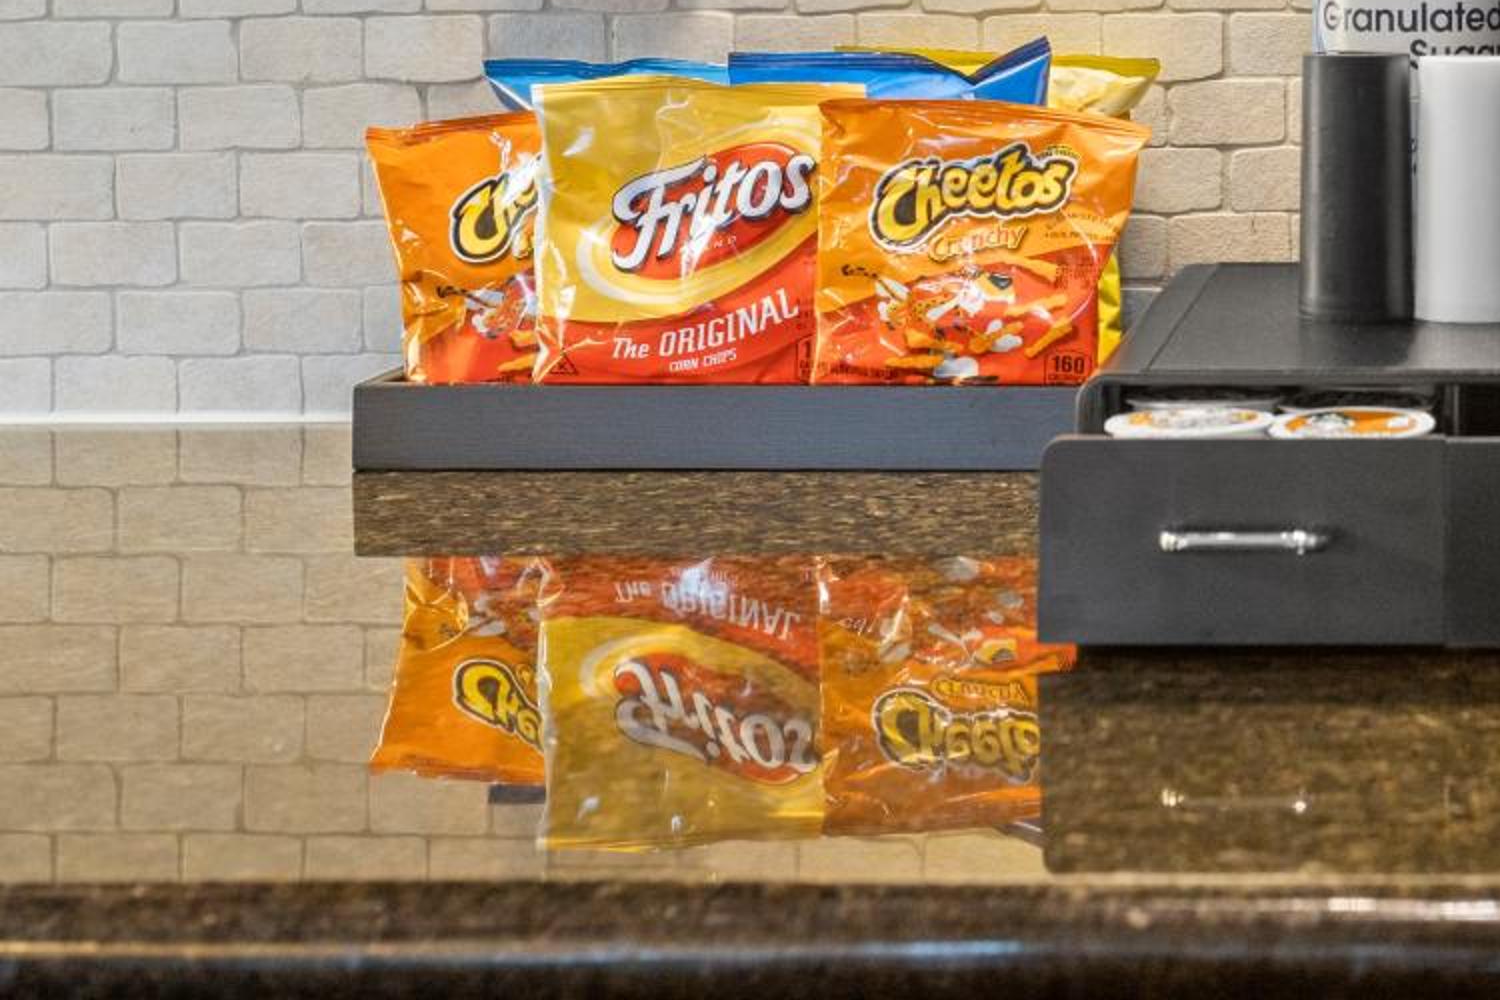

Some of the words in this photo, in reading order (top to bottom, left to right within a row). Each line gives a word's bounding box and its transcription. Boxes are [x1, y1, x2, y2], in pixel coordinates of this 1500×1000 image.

[612, 154, 815, 272] Fritos
[870, 142, 1078, 253] Cheetos
[612, 337, 650, 360] The
[659, 287, 799, 357] ORIGINAL
[669, 356, 699, 372] CORN
[703, 348, 737, 367] CHIPS
[1053, 355, 1085, 374] 160
